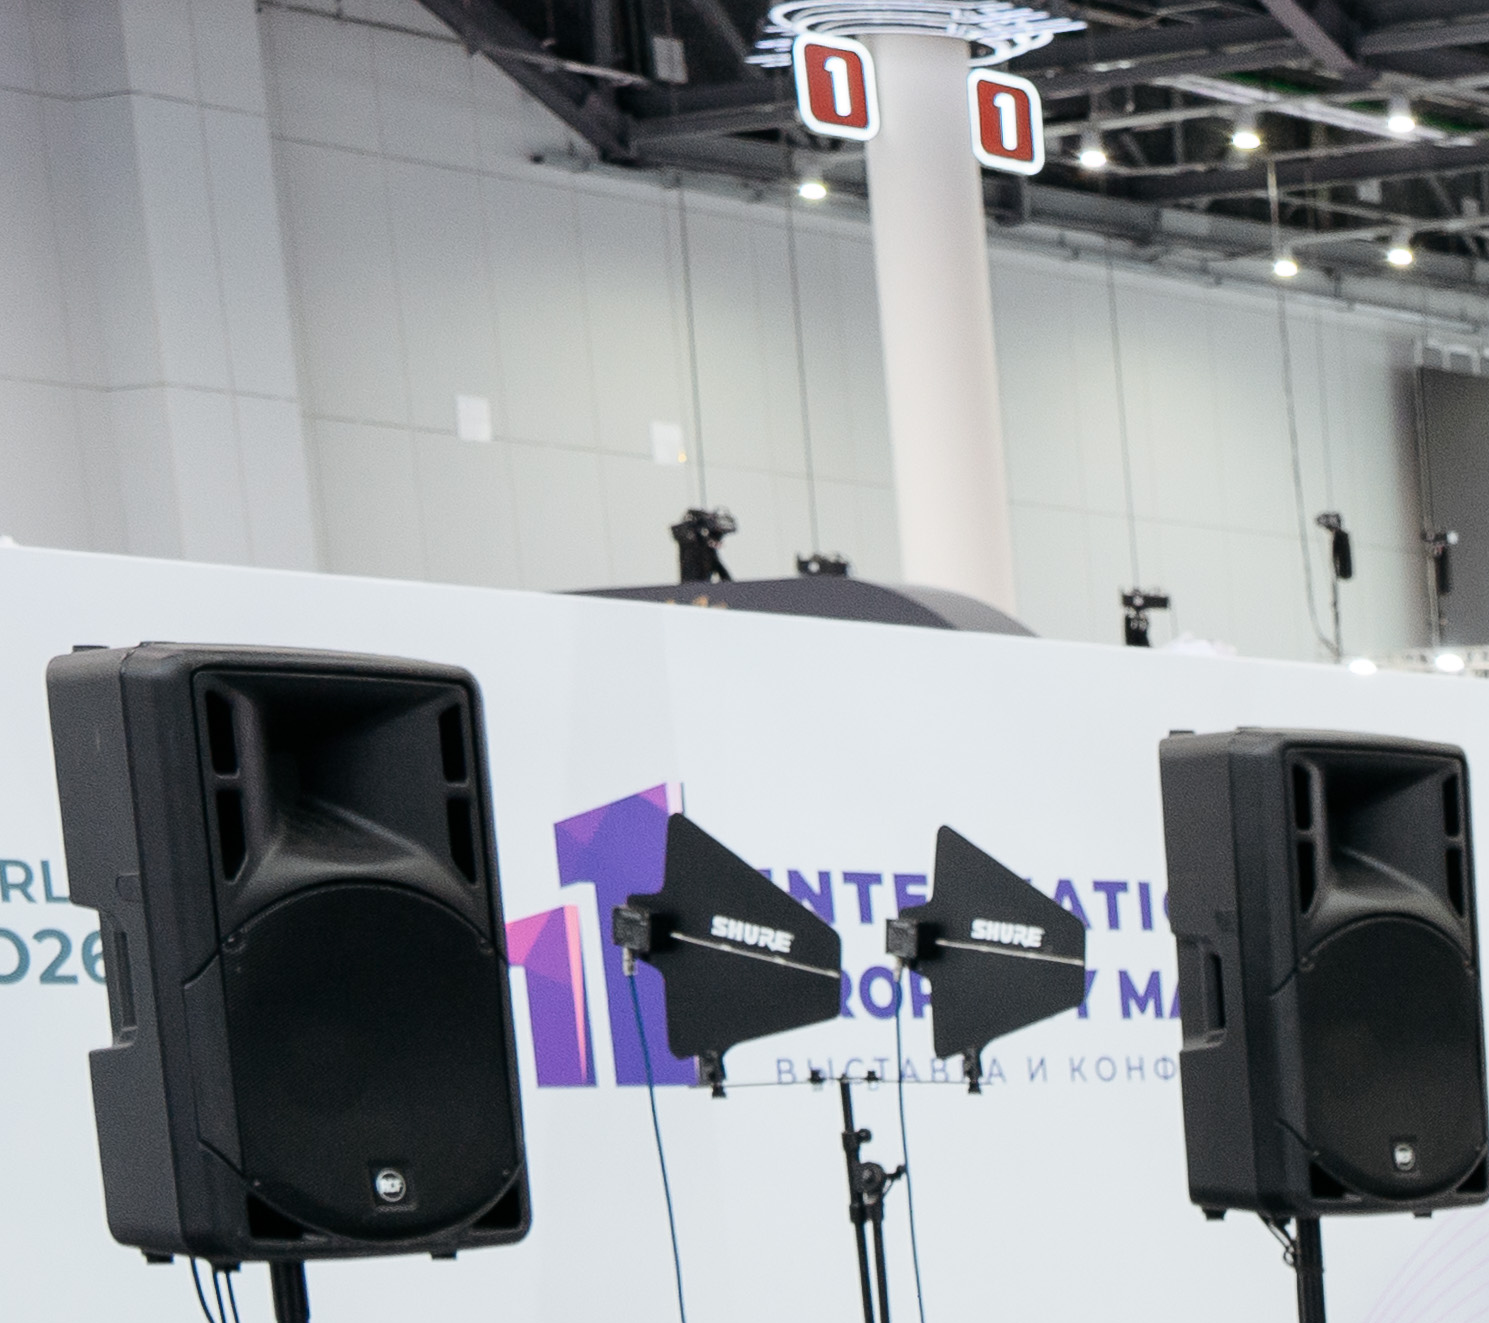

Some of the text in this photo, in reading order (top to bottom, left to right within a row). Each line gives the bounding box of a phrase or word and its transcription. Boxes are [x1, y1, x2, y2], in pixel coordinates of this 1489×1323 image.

[824, 56, 851, 117] 1
[993, 92, 1018, 151] 1
[711, 915, 795, 953] SHURE
[969, 918, 1045, 948] SHURE
[1028, 1057, 1048, 1082] И
